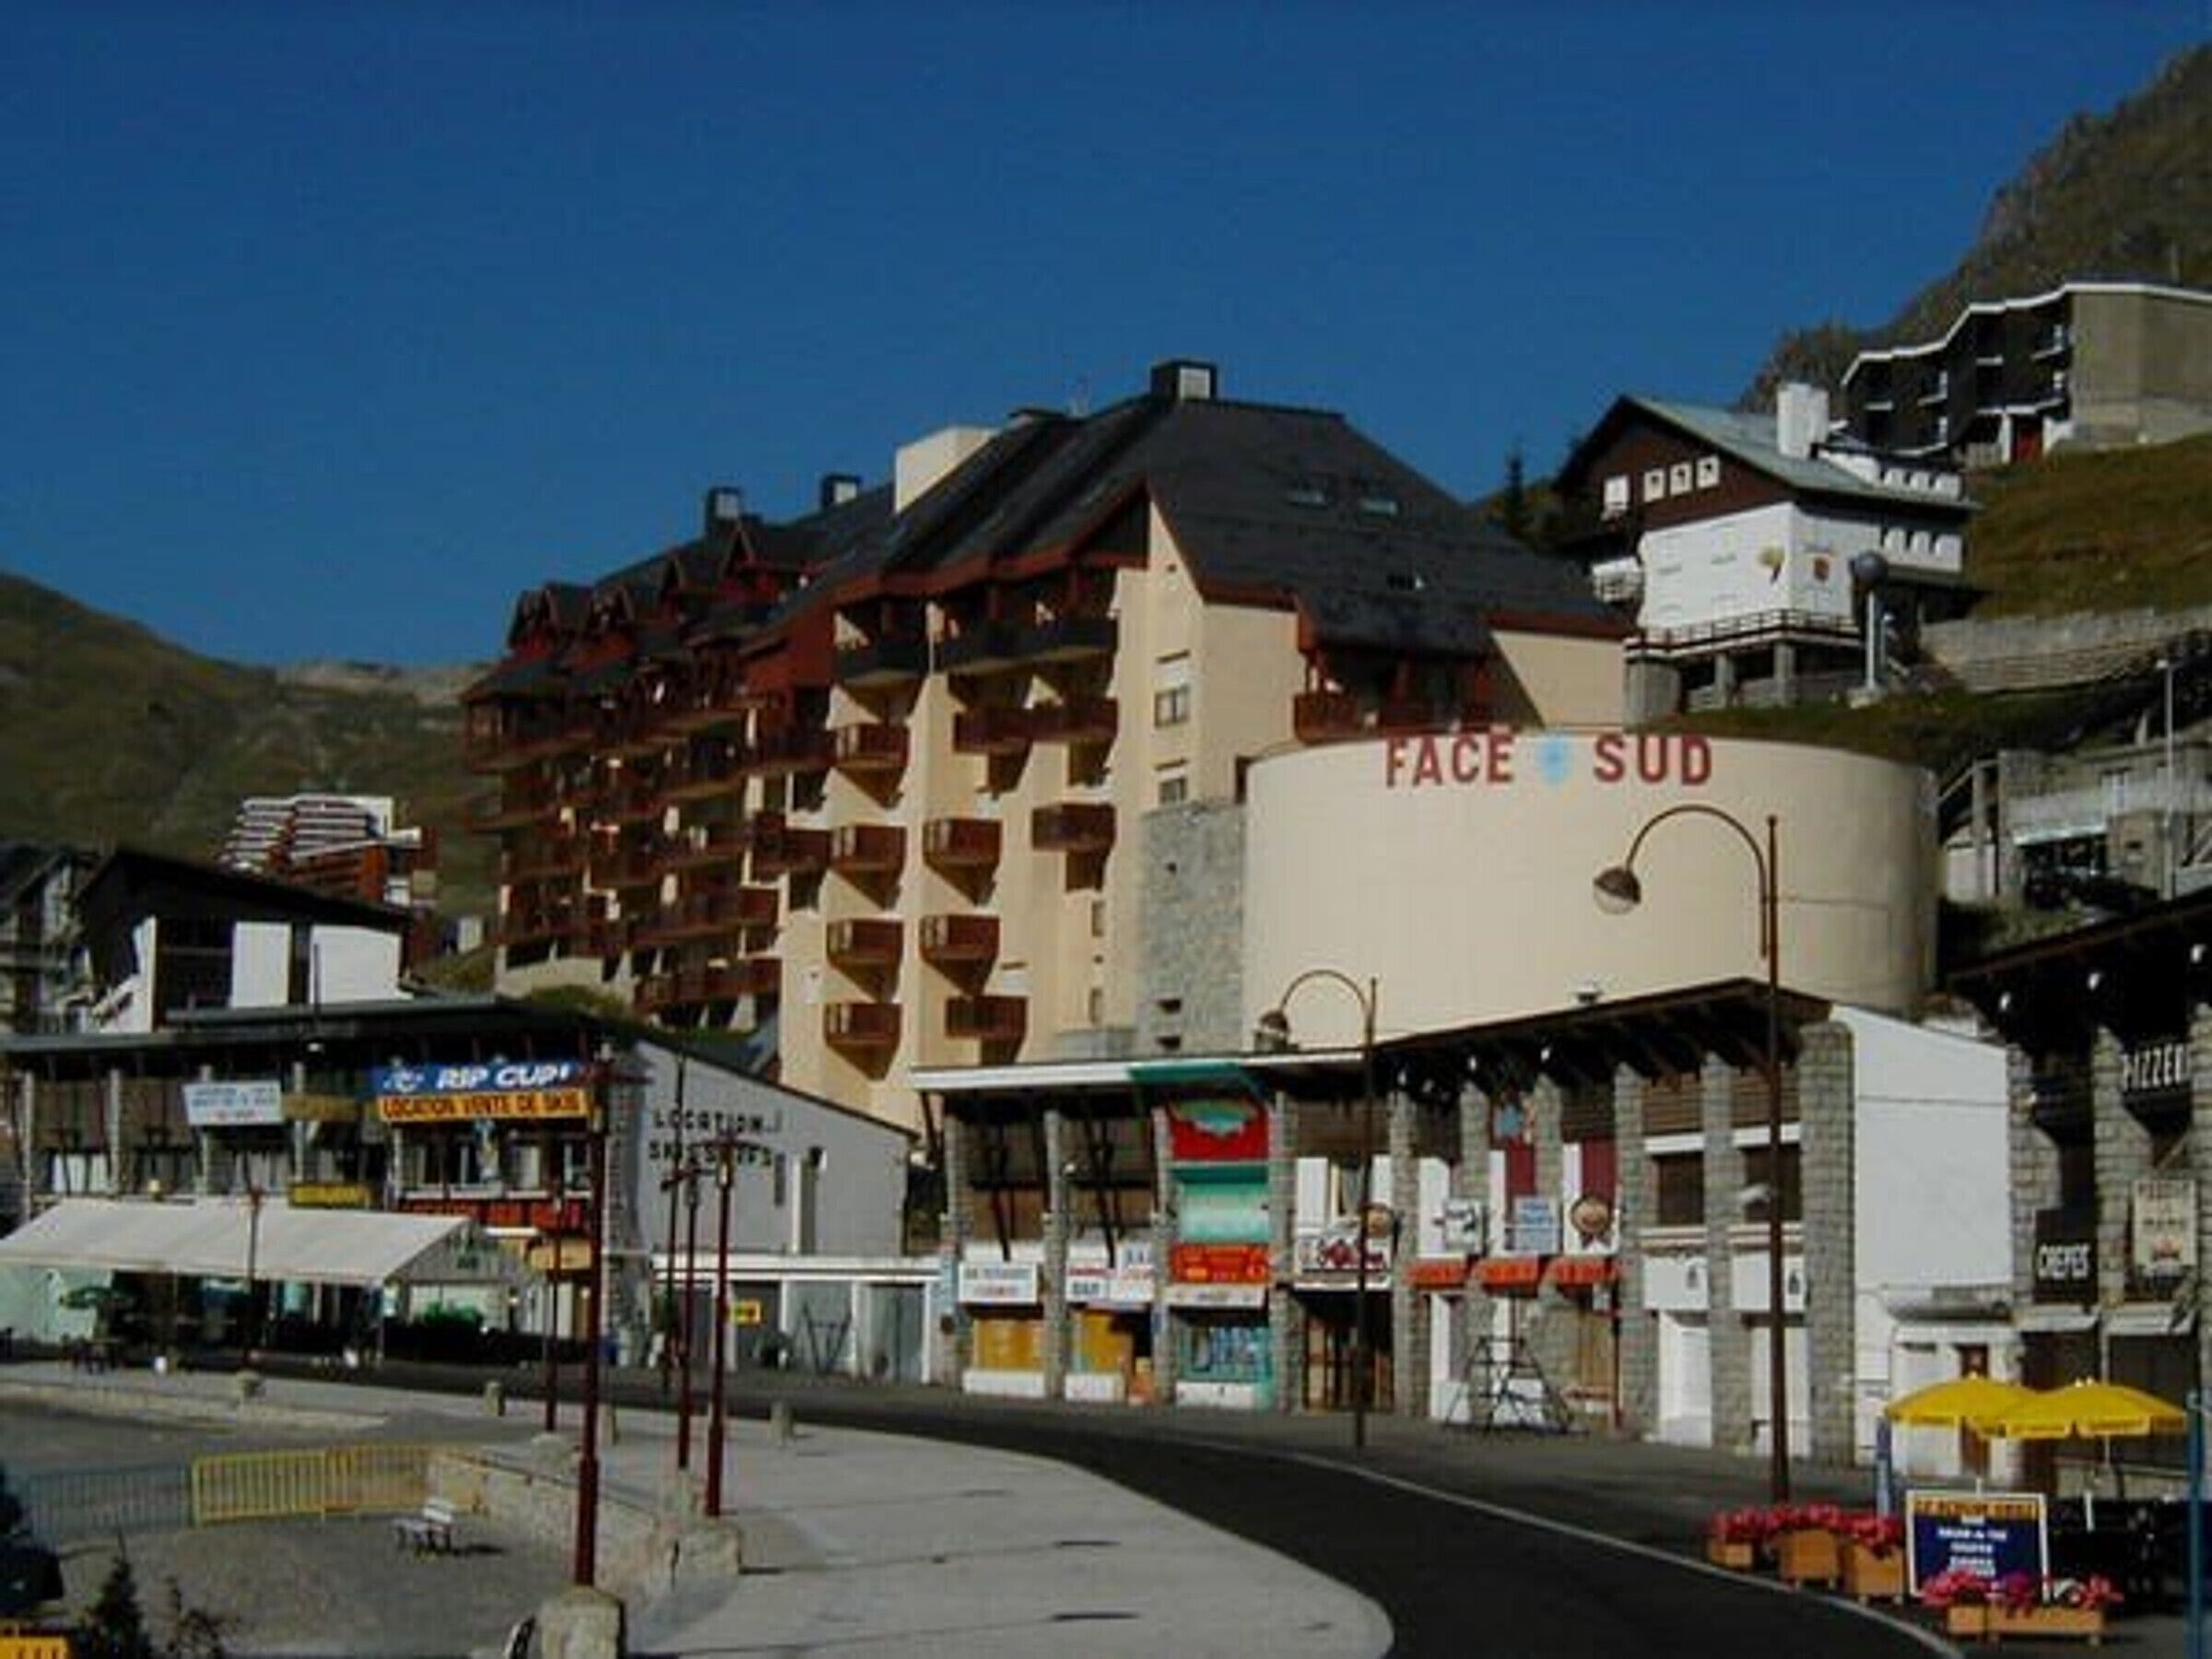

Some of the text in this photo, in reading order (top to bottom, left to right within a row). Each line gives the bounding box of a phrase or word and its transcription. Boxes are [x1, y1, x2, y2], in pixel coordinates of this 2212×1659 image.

[1385, 730, 1712, 787] FACE SUD
[435, 1065, 490, 1089] RIP
[382, 1094, 455, 1119] LOCATION
[463, 1093, 511, 1117] VENTE
[517, 1093, 540, 1114] DE
[653, 1109, 765, 1134] LOCATION
